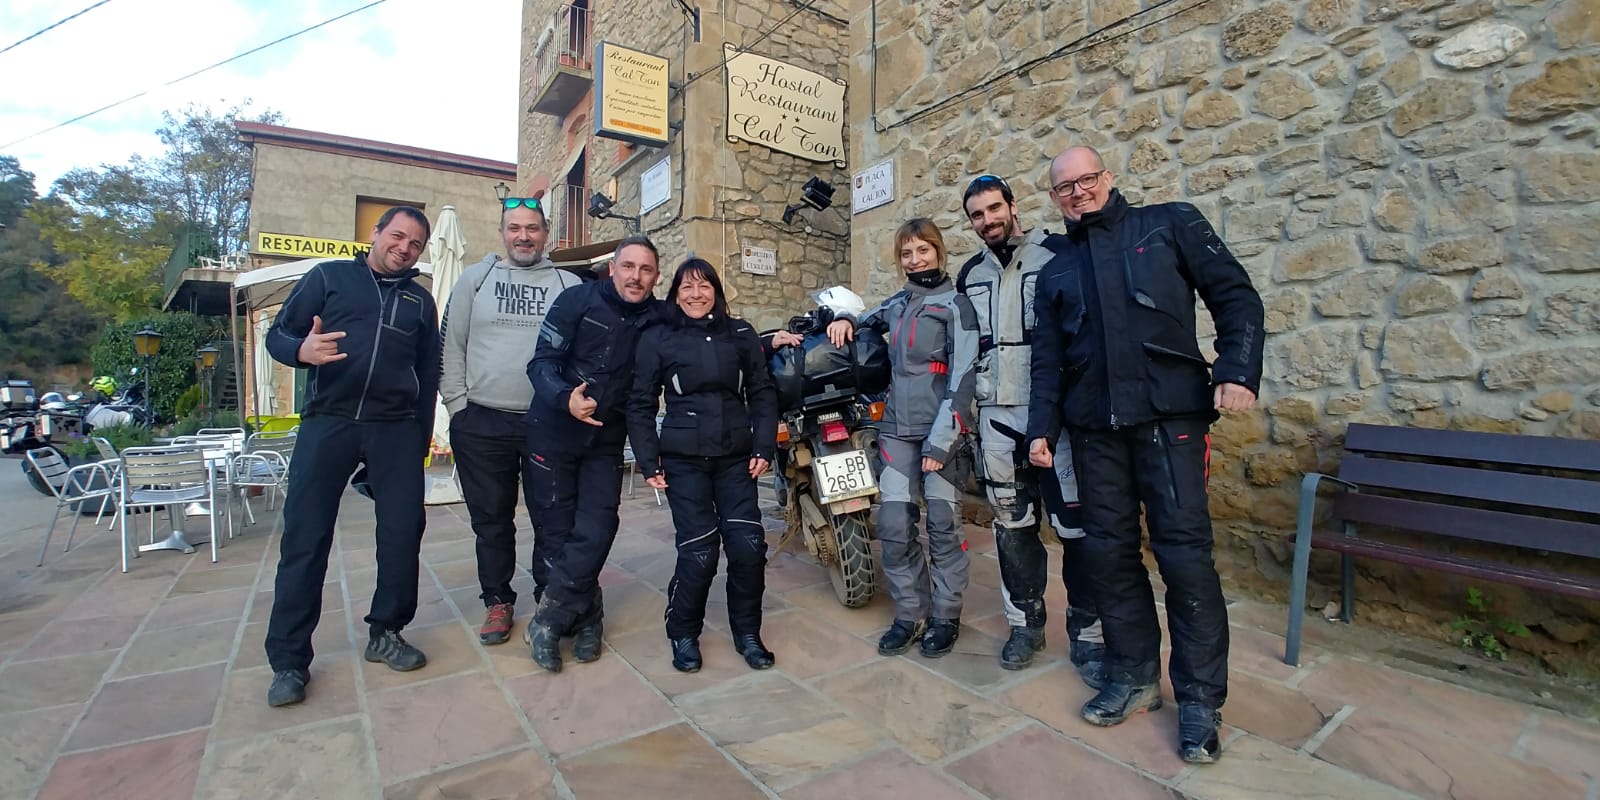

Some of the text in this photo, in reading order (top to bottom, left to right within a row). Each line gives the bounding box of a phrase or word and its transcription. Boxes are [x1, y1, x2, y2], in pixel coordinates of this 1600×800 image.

[606, 50, 665, 72] Restaurant
[610, 64, 634, 80] Cal
[635, 70, 660, 87] Ton
[755, 63, 823, 99] Hostal
[731, 75, 840, 123] Restaurant
[734, 113, 841, 158] Cal Ton
[494, 281, 549, 301] NINETY
[496, 296, 546, 316] THREE
[818, 411, 840, 421] YAMAHA
[820, 462, 829, 478] T
[845, 456, 866, 473] BB
[827, 471, 866, 493] 2651
